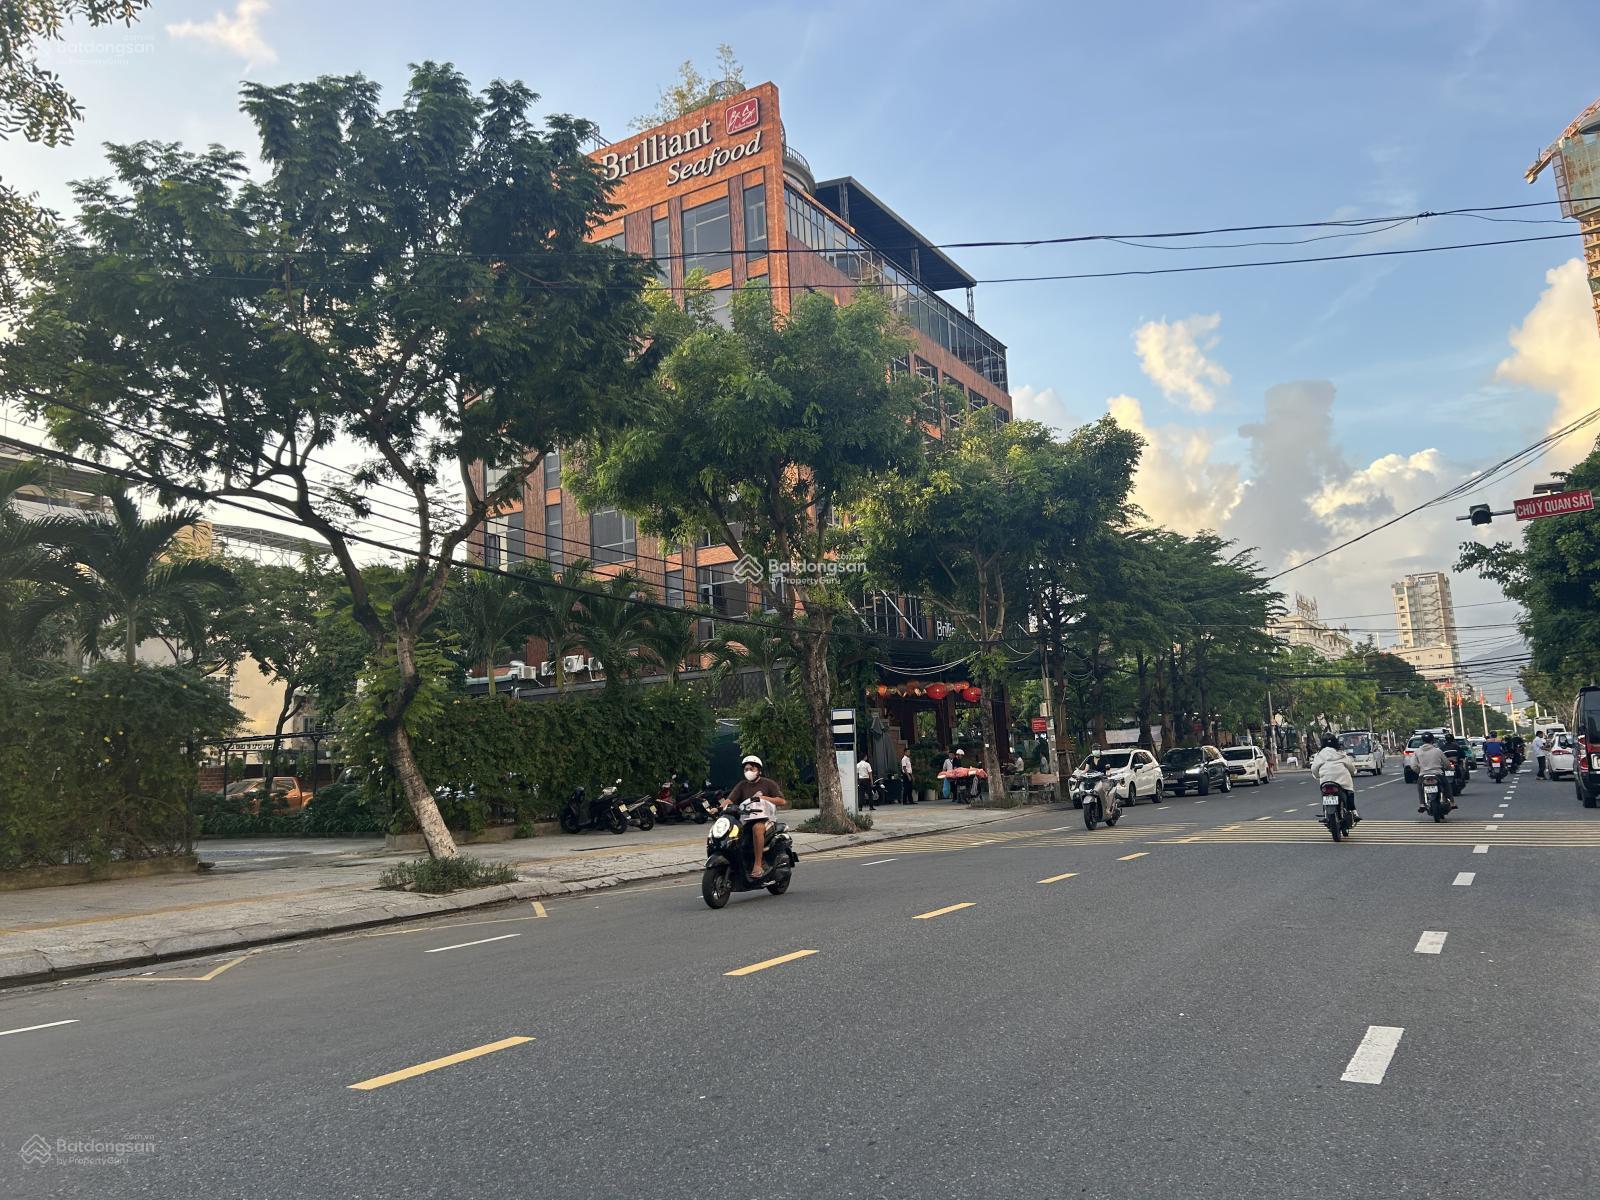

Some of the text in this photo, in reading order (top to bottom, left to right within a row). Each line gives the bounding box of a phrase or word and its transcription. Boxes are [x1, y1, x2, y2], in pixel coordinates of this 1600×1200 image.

[600, 118, 712, 181] Brilliant
[666, 131, 762, 186] Seafood
[1517, 494, 1590, 516] CHÚ Ý QUAN SÁT
